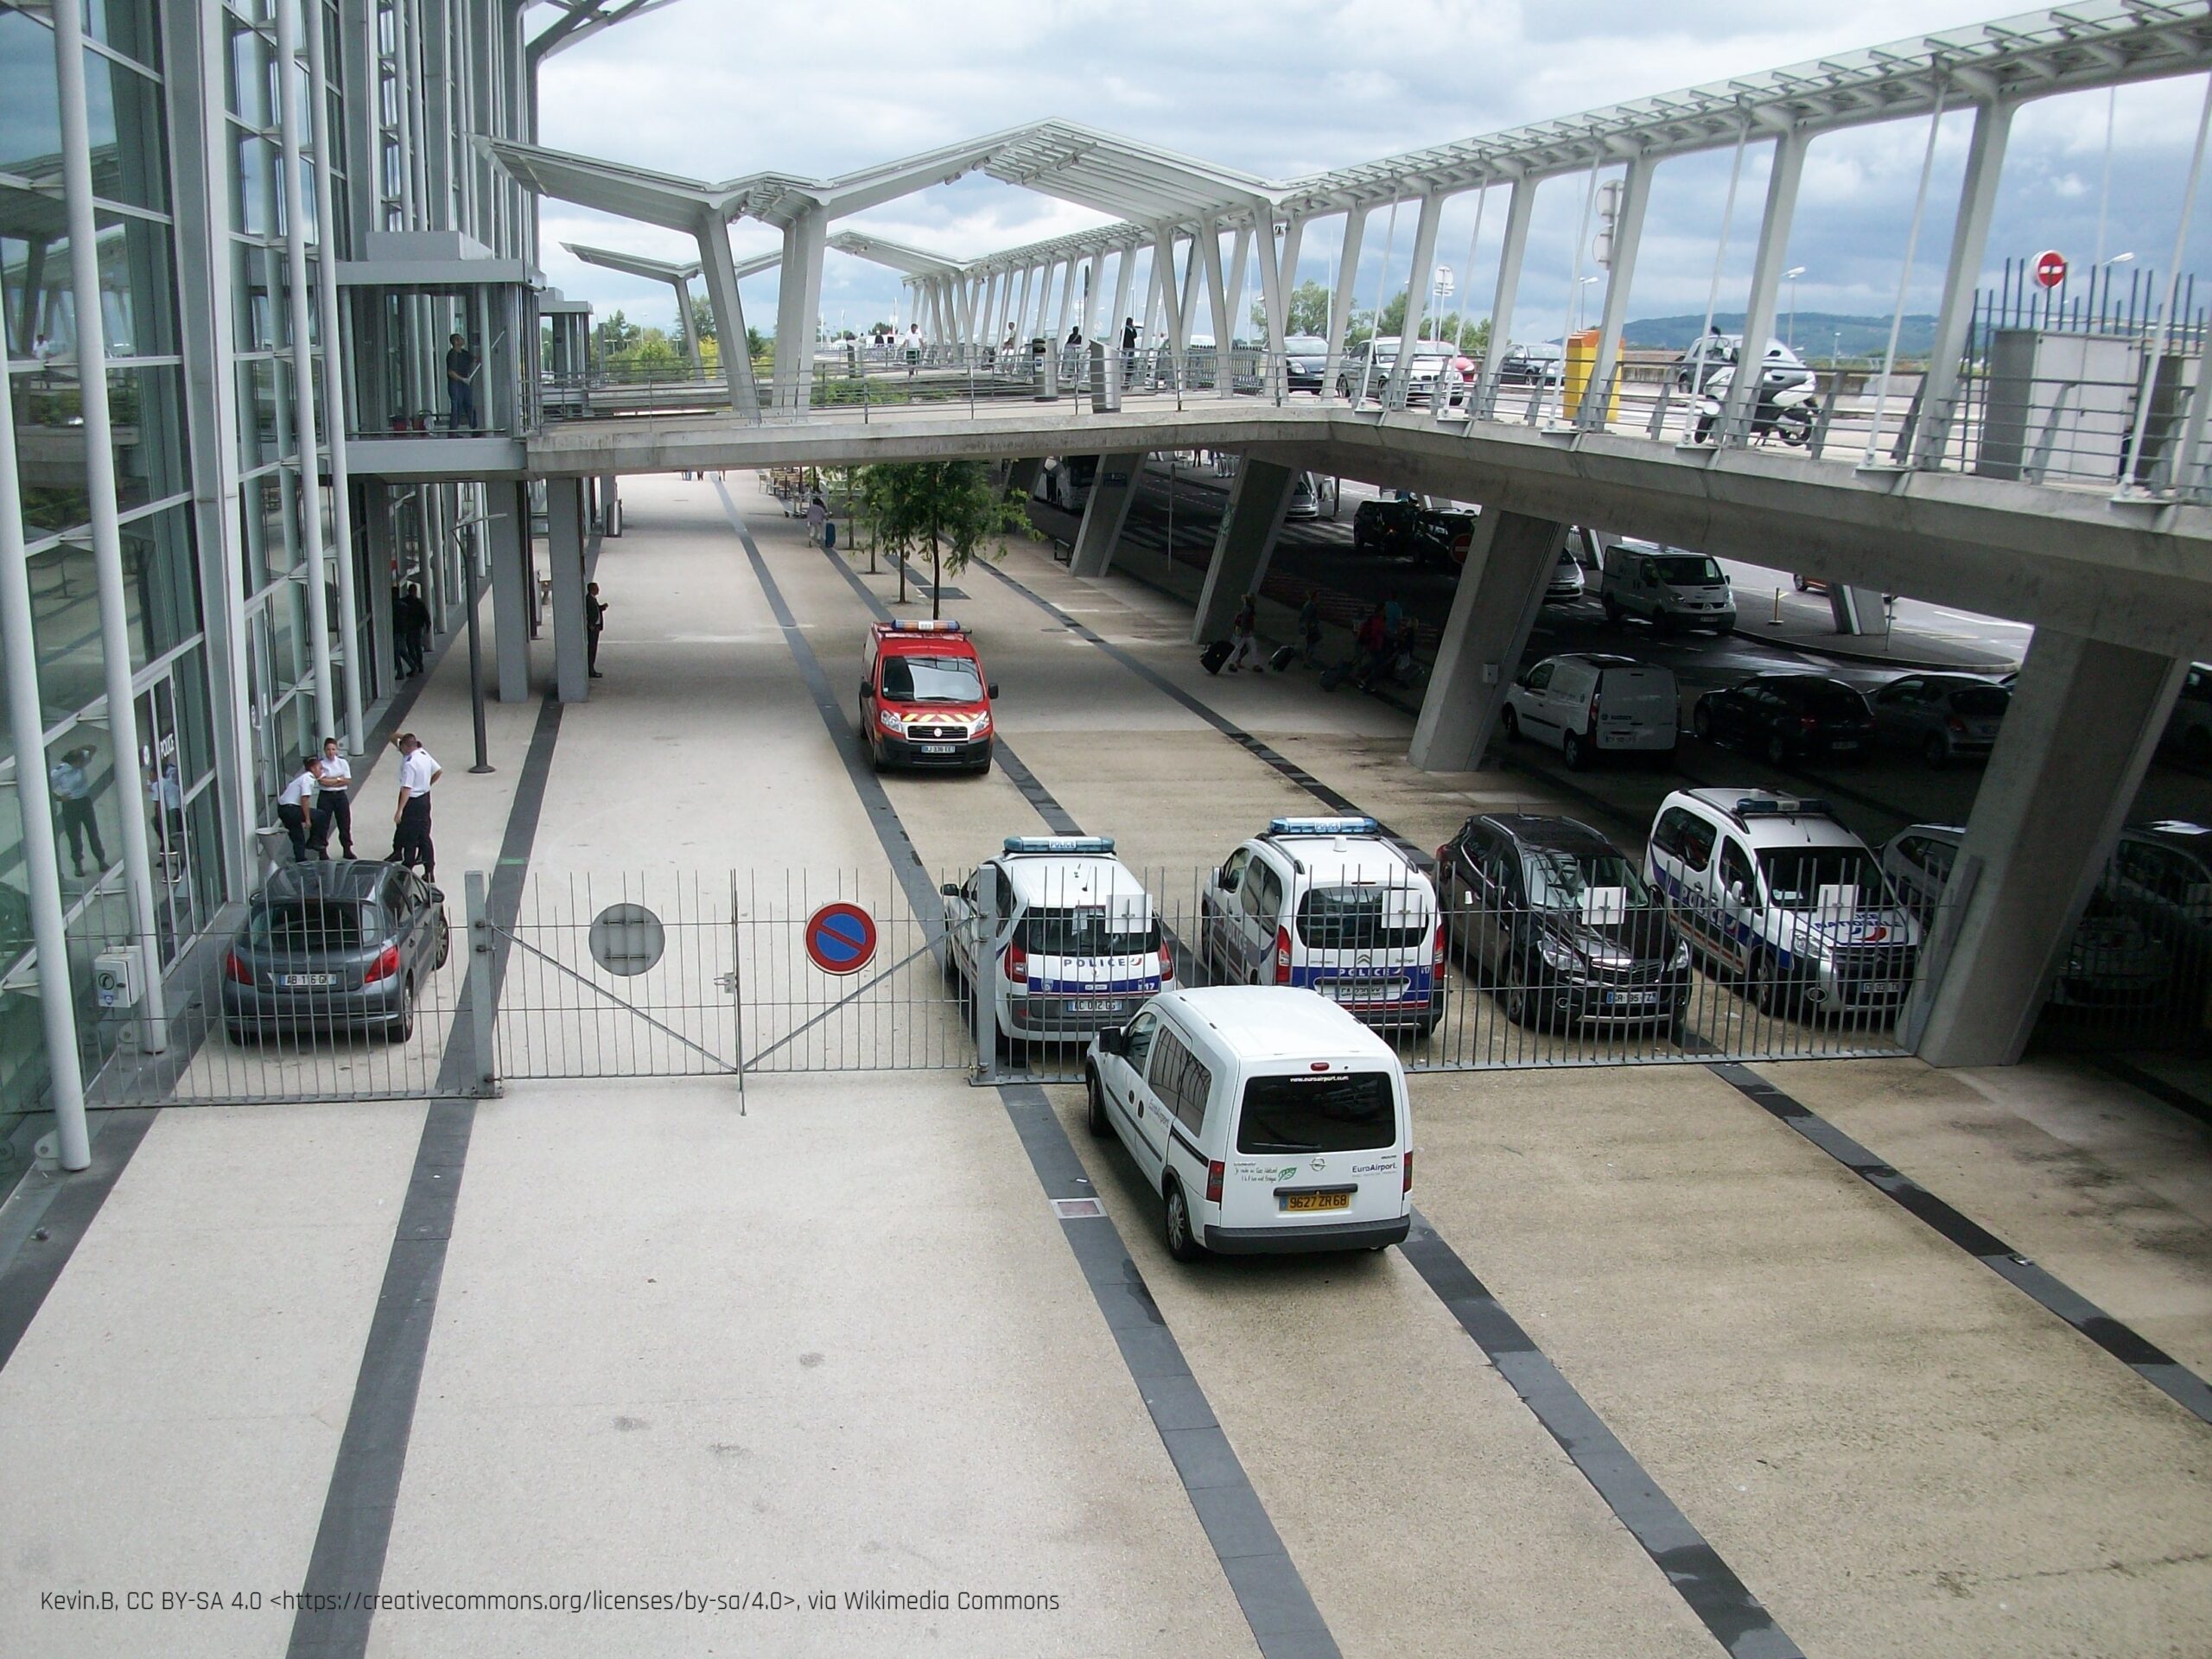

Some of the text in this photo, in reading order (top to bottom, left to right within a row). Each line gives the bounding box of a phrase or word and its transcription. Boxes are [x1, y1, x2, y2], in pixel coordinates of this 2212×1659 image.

[1064, 958, 1126, 967] POLICE
[1339, 968, 1390, 976] POLICE
[1289, 1194, 1347, 1209] 9627 ZR 68
